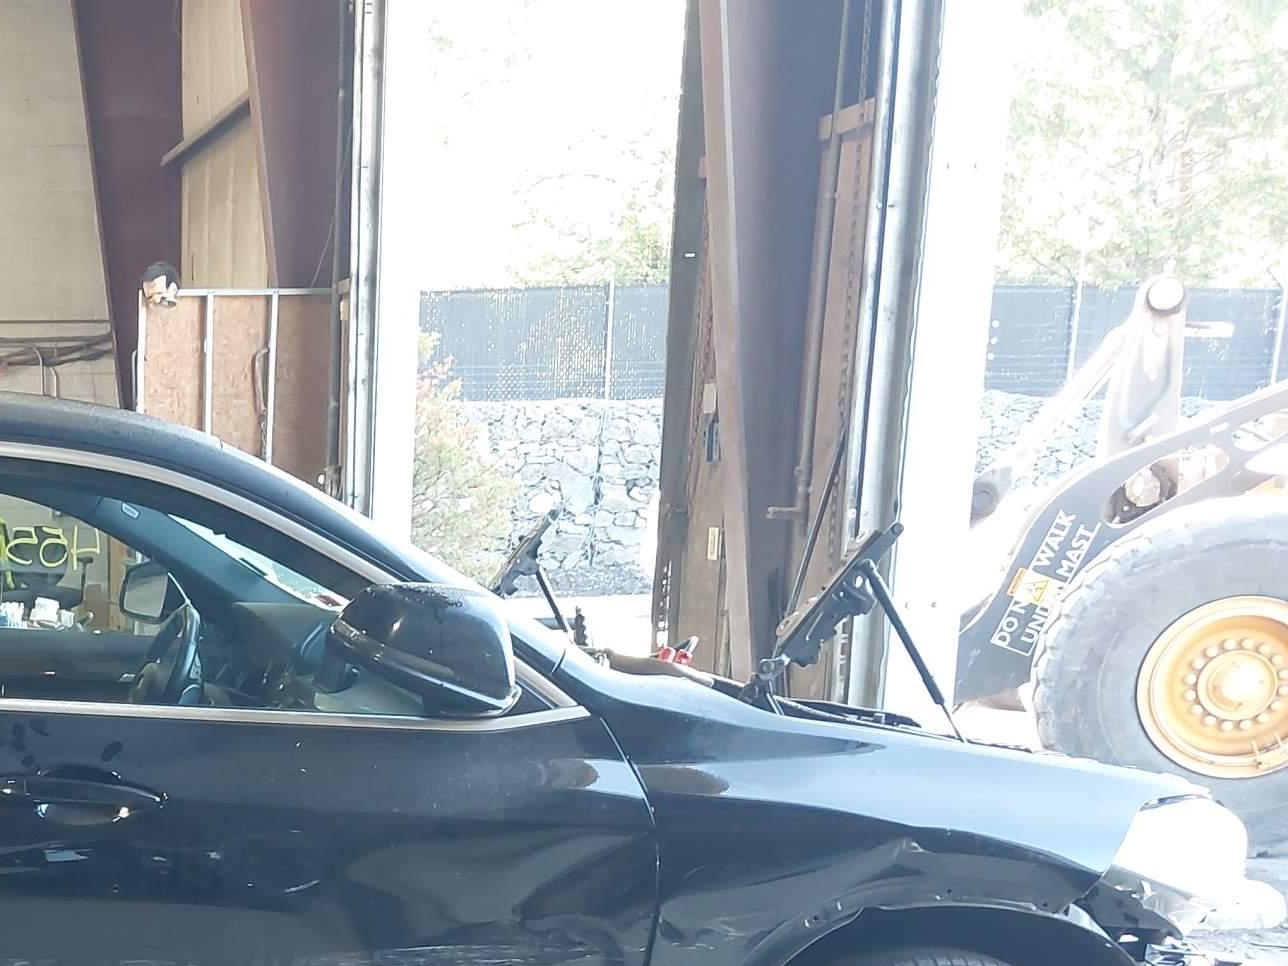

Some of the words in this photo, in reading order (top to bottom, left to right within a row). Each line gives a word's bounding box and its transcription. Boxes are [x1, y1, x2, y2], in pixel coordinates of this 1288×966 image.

[996, 617, 1019, 647] DO
[1034, 510, 1077, 567] WALK
[1056, 524, 1094, 577] MAST
